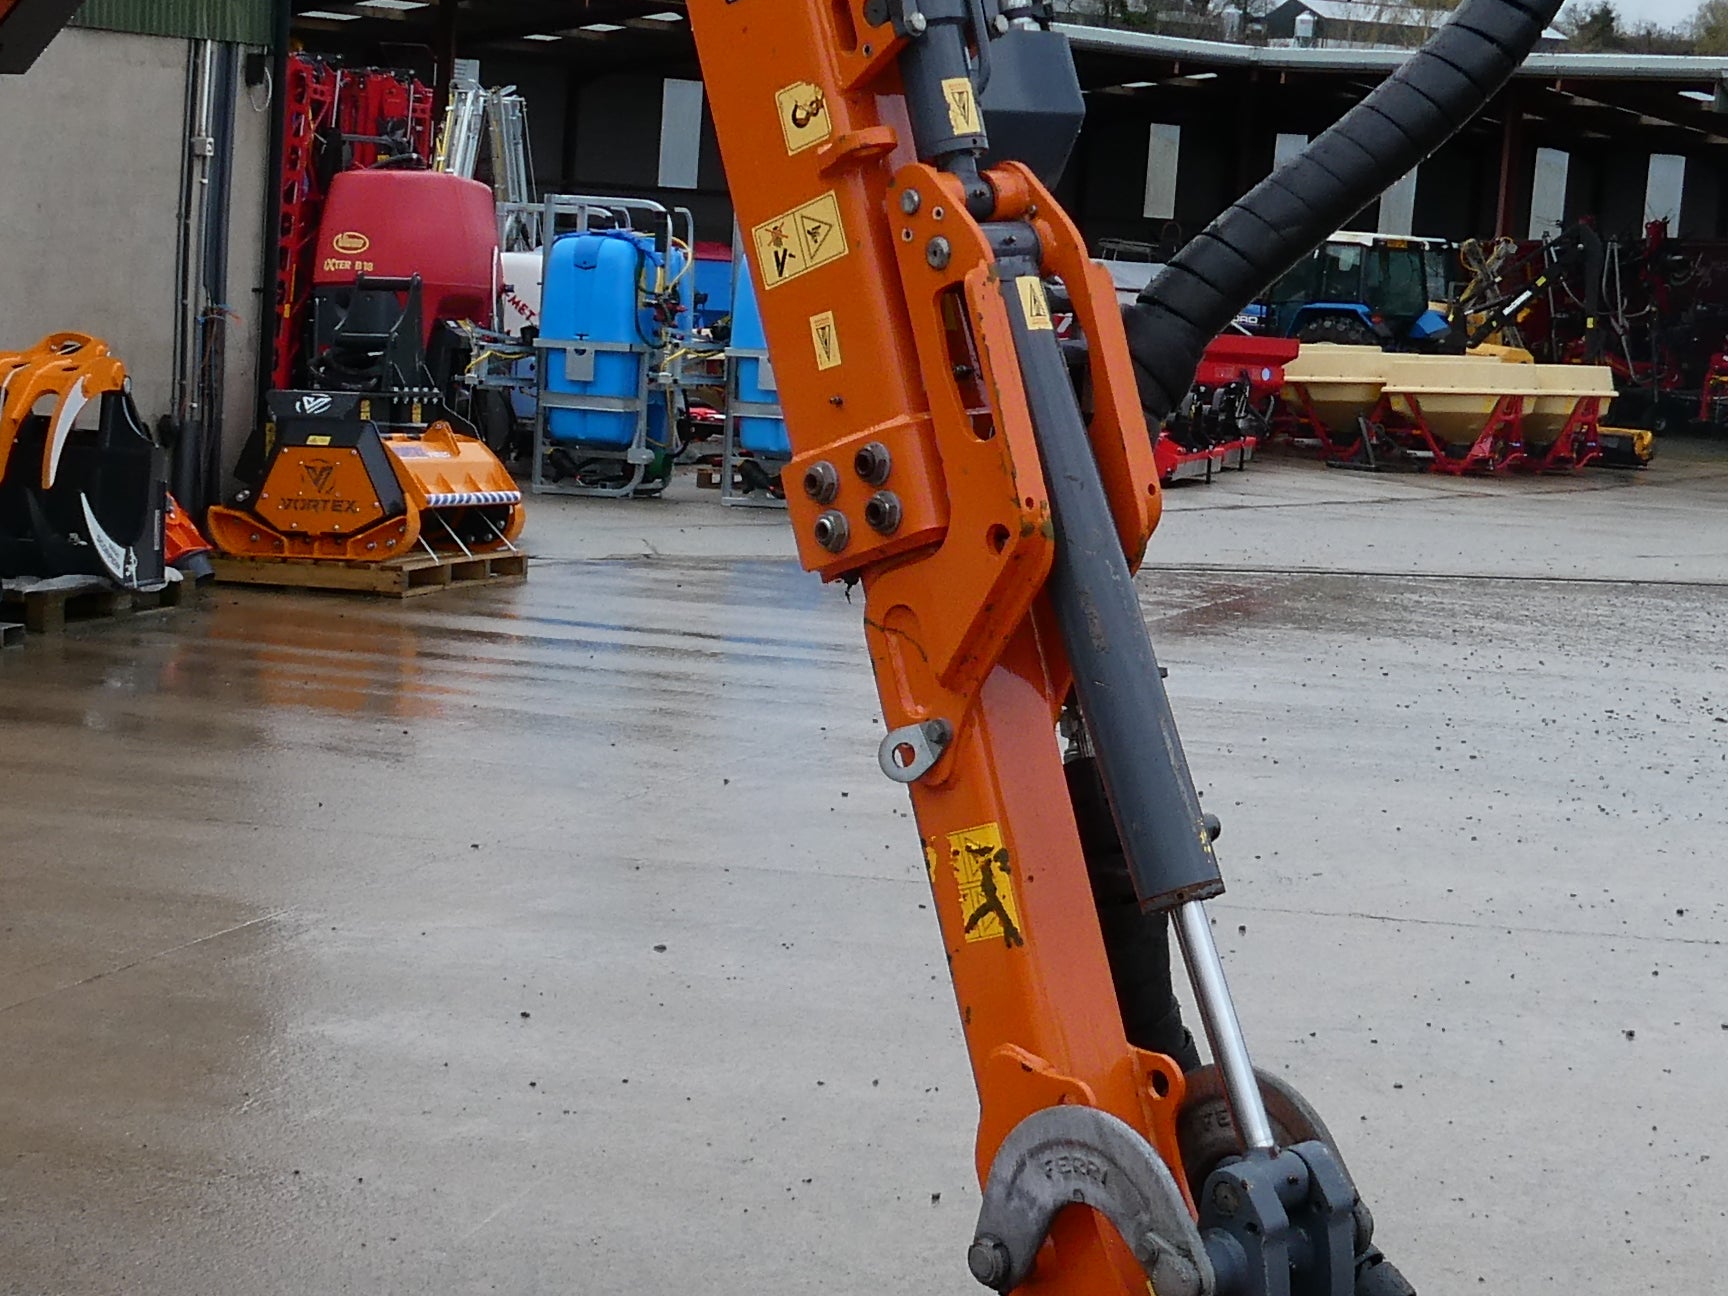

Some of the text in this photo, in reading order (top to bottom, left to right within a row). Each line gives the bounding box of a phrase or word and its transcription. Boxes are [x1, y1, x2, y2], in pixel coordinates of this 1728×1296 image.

[1232, 315, 1258, 324] ORD
[281, 497, 358, 514] VORTEX
[1044, 1155, 1109, 1186] FERRI
